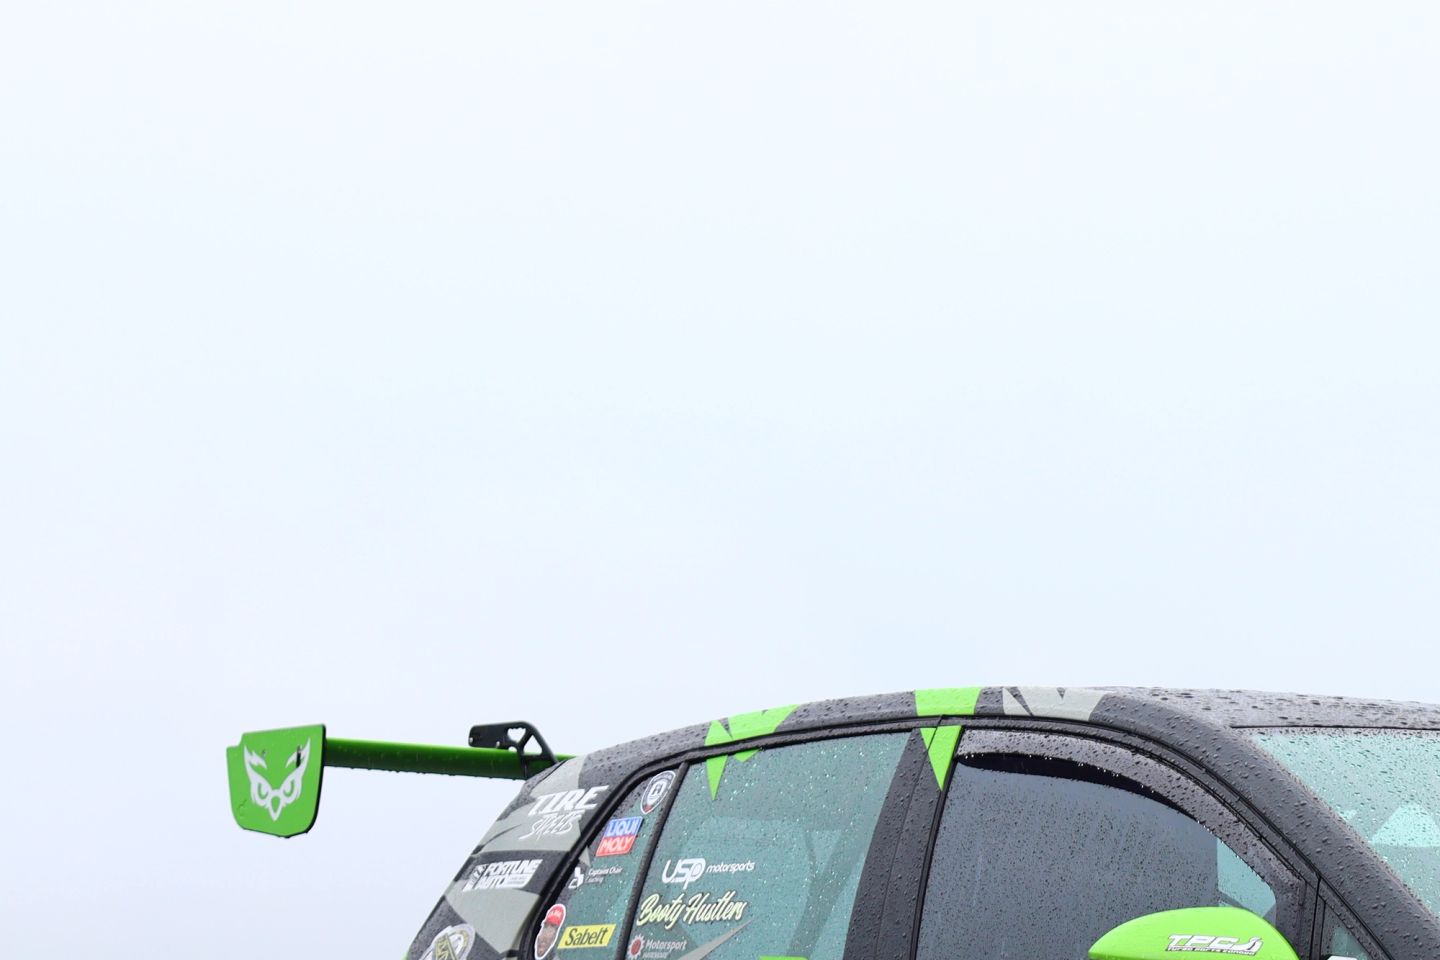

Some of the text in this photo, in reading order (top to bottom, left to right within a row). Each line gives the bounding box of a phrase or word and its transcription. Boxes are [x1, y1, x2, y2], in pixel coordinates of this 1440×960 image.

[527, 784, 610, 818] TIRE
[604, 819, 641, 837] LIQUI
[599, 836, 635, 852] MOLY
[483, 859, 543, 876] FORTUNE
[661, 857, 756, 890] USP motorsports
[474, 875, 507, 890] AUTO
[636, 892, 686, 930] Booty
[565, 927, 608, 946] Sabelt
[645, 939, 688, 953] Motorsport
